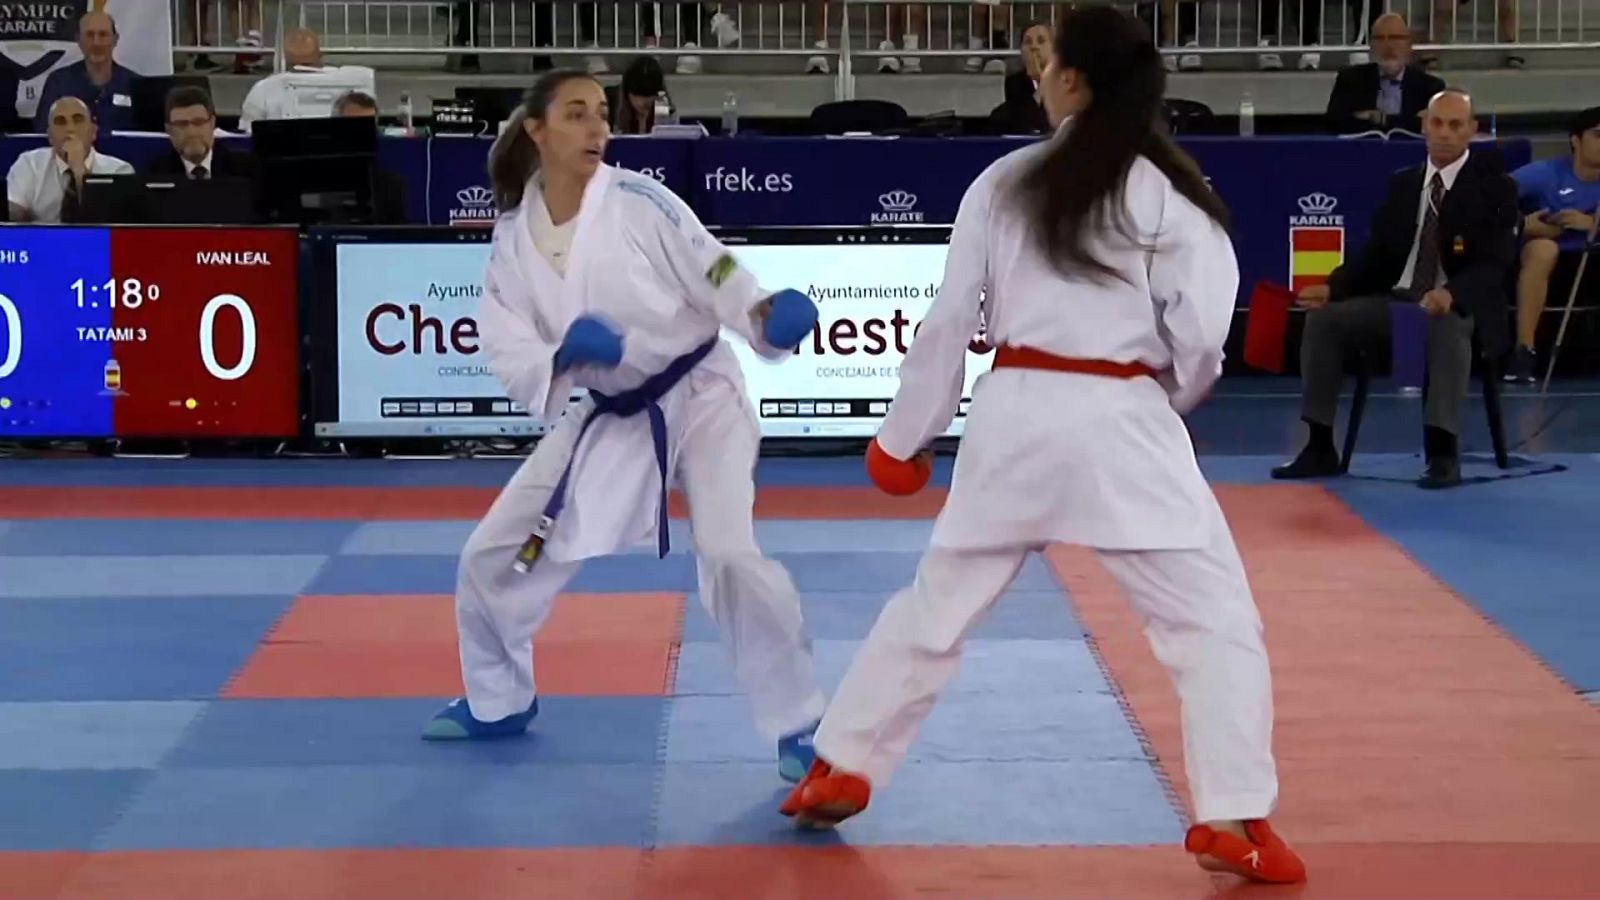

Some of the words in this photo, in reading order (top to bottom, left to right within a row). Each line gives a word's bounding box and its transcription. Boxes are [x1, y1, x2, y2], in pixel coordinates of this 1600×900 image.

[705, 166, 793, 192] rfek.es
[871, 212, 924, 222] KARATE
[1289, 215, 1344, 226] KARATE
[0, 250, 16, 264] HI
[196, 252, 231, 265] IVAN
[235, 252, 271, 265] LEAL
[70, 278, 143, 308] 1:18
[147, 284, 160, 300] 0
[427, 282, 483, 301] Ayunta
[807, 283, 920, 302] Ayuntamiento
[76, 328, 134, 341] TATAMI
[137, 328, 148, 341] 3
[200, 293, 257, 381] 0
[365, 302, 480, 356] Che
[438, 365, 493, 377] CONCEJAL
